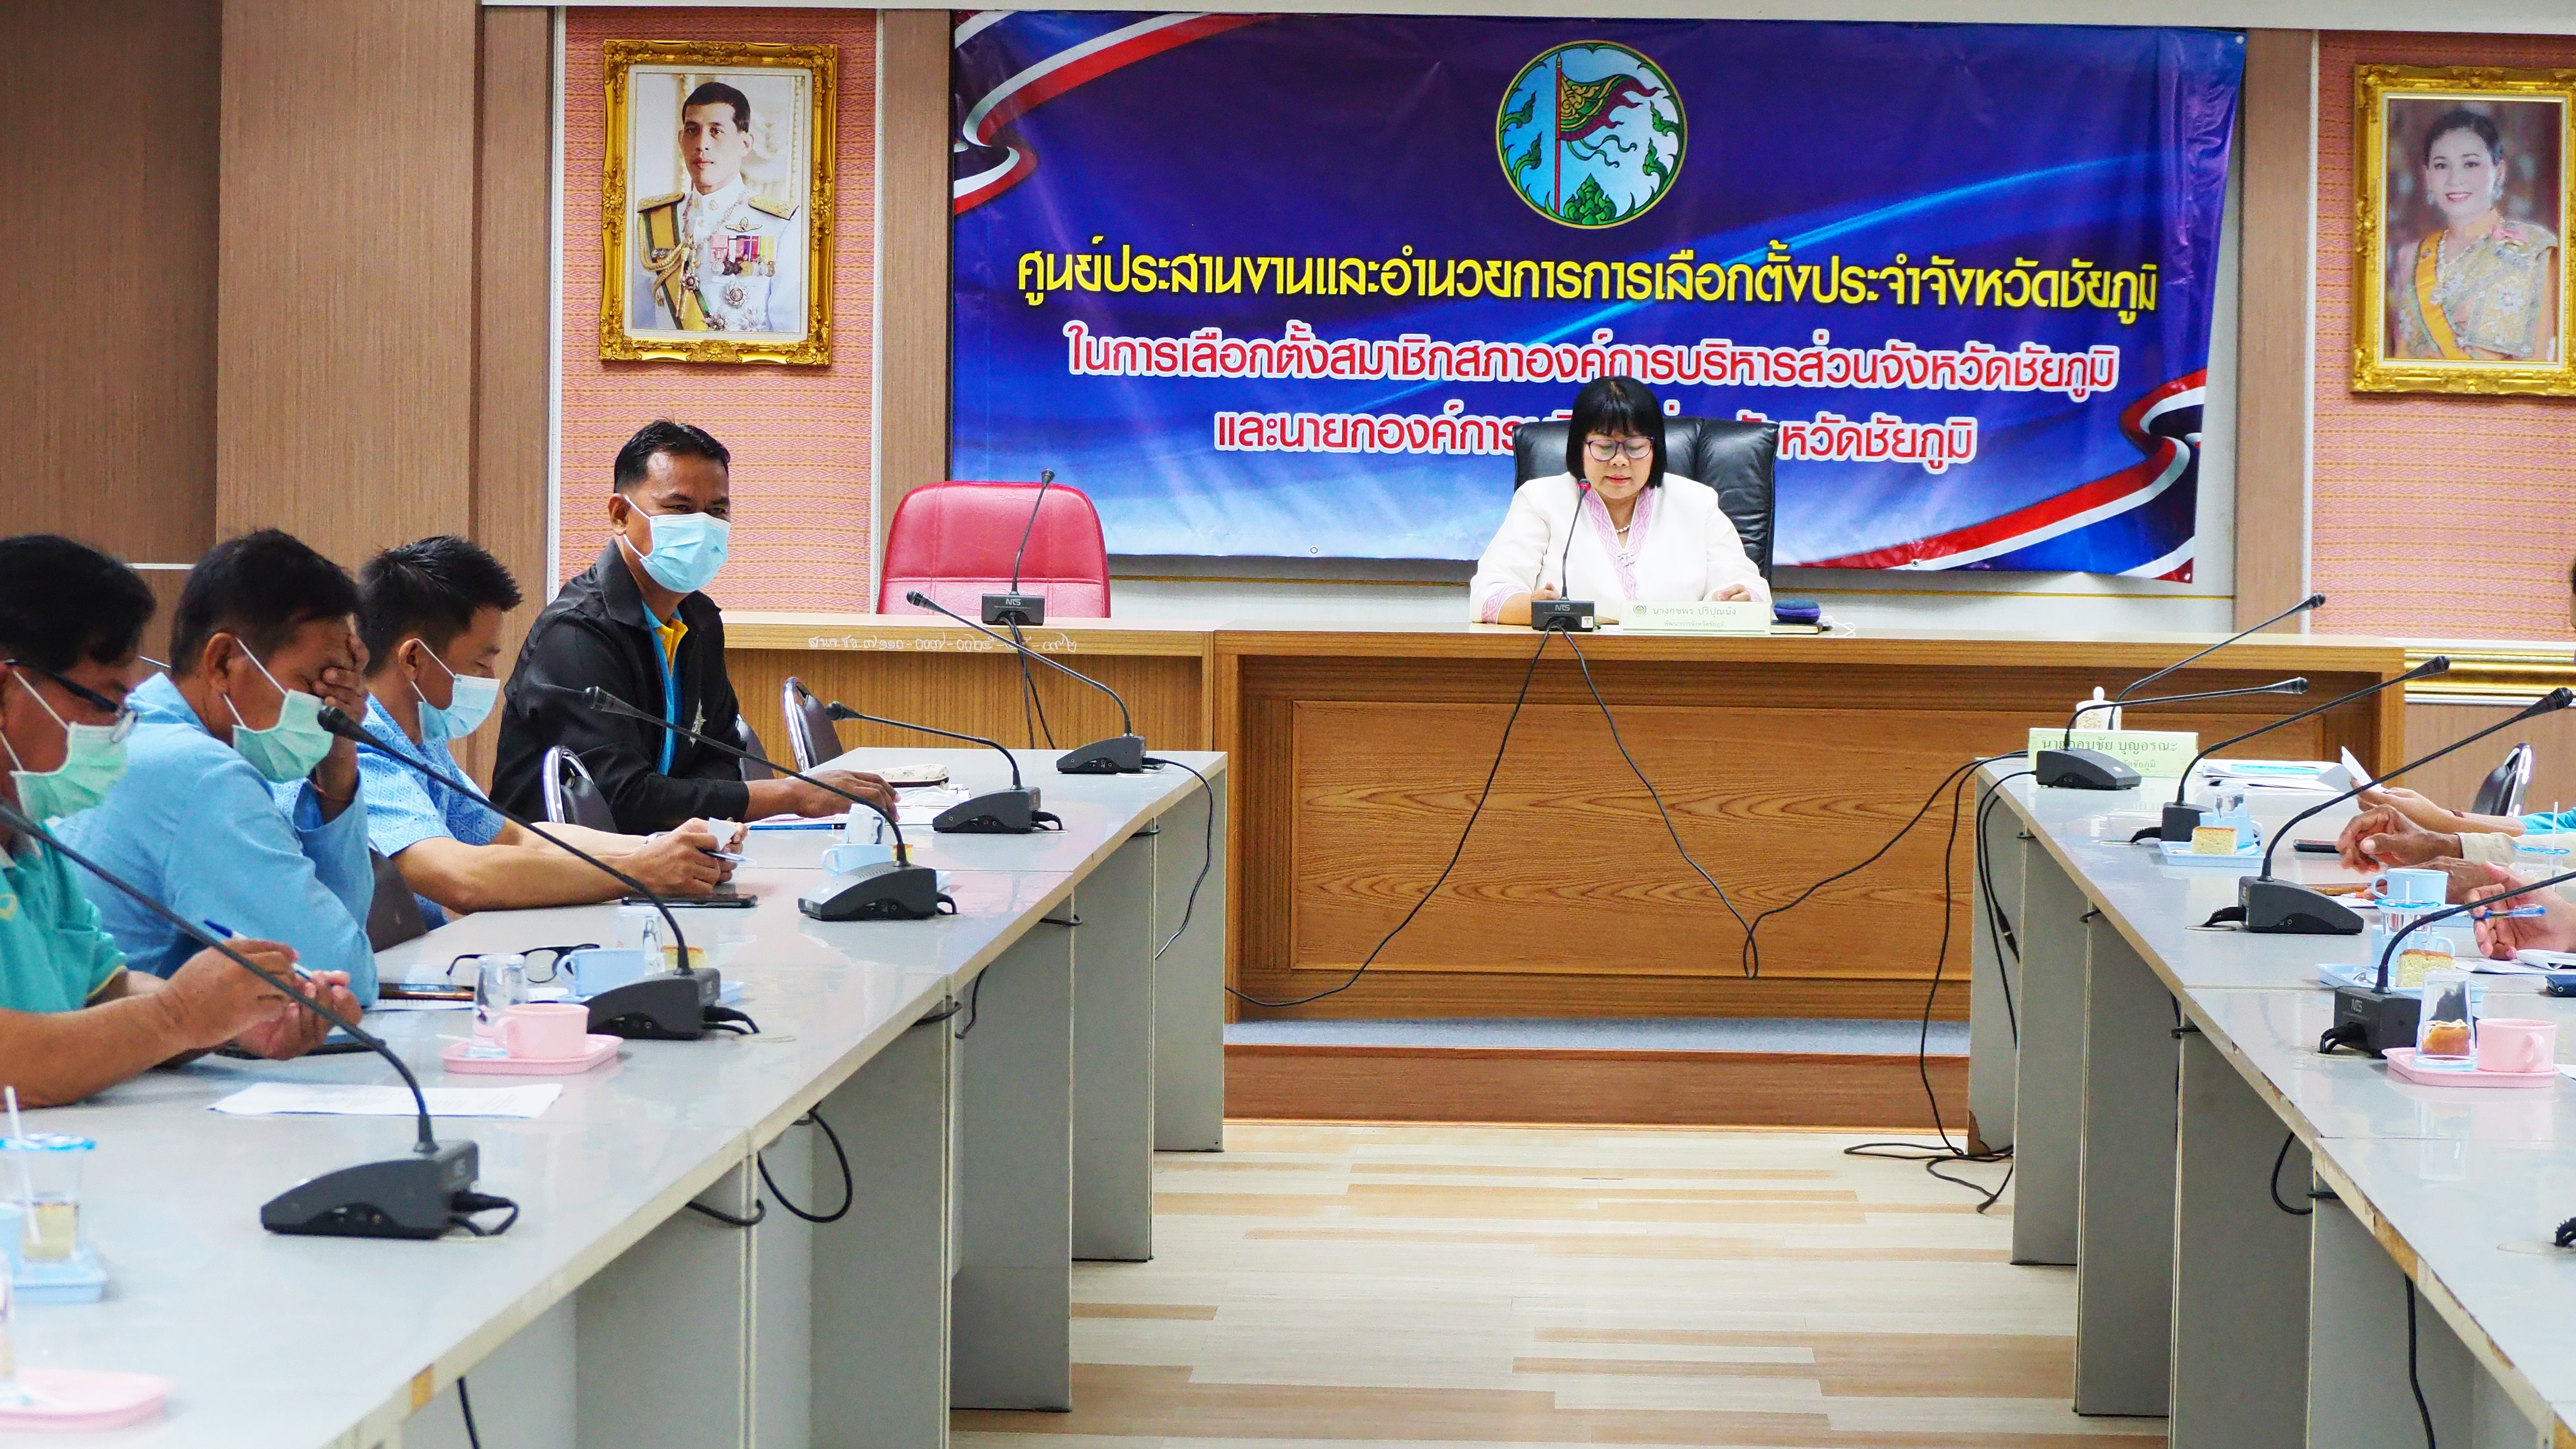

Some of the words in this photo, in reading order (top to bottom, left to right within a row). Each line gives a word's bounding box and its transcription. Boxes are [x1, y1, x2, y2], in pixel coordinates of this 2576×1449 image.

[1018, 235, 2157, 325] ศูนย์ประสานงานและอำนวยการการเลือกตั้งประจำจังหวัดชัยภูมิ
[1067, 323, 2115, 399] ในการเลือกตั้งสมาชิกสภาองค์การบริหารส่วนจังหวัดชัยภูมิ
[2118, 741, 2178, 755] บุญอรณะ
